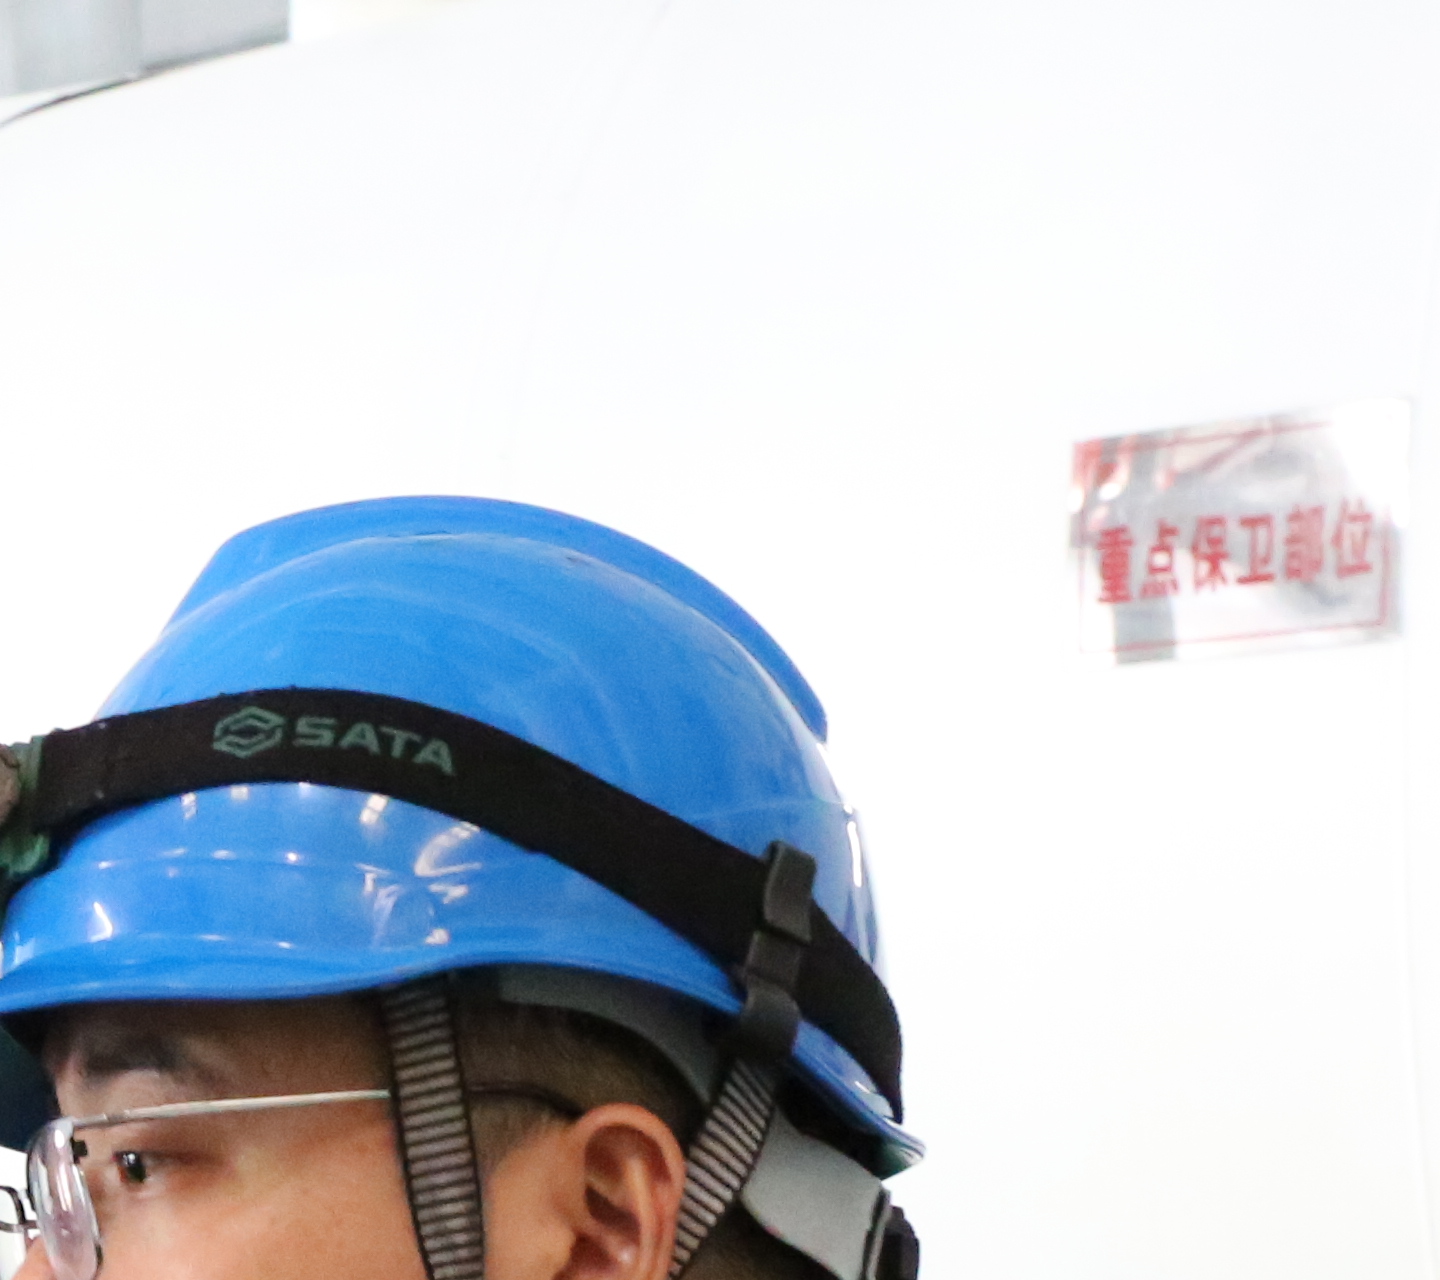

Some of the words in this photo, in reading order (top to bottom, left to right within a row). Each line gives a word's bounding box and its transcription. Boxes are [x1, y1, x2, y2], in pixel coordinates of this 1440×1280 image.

[1097, 497, 1372, 603] 重点保卫部位
[292, 715, 455, 776] SATA
